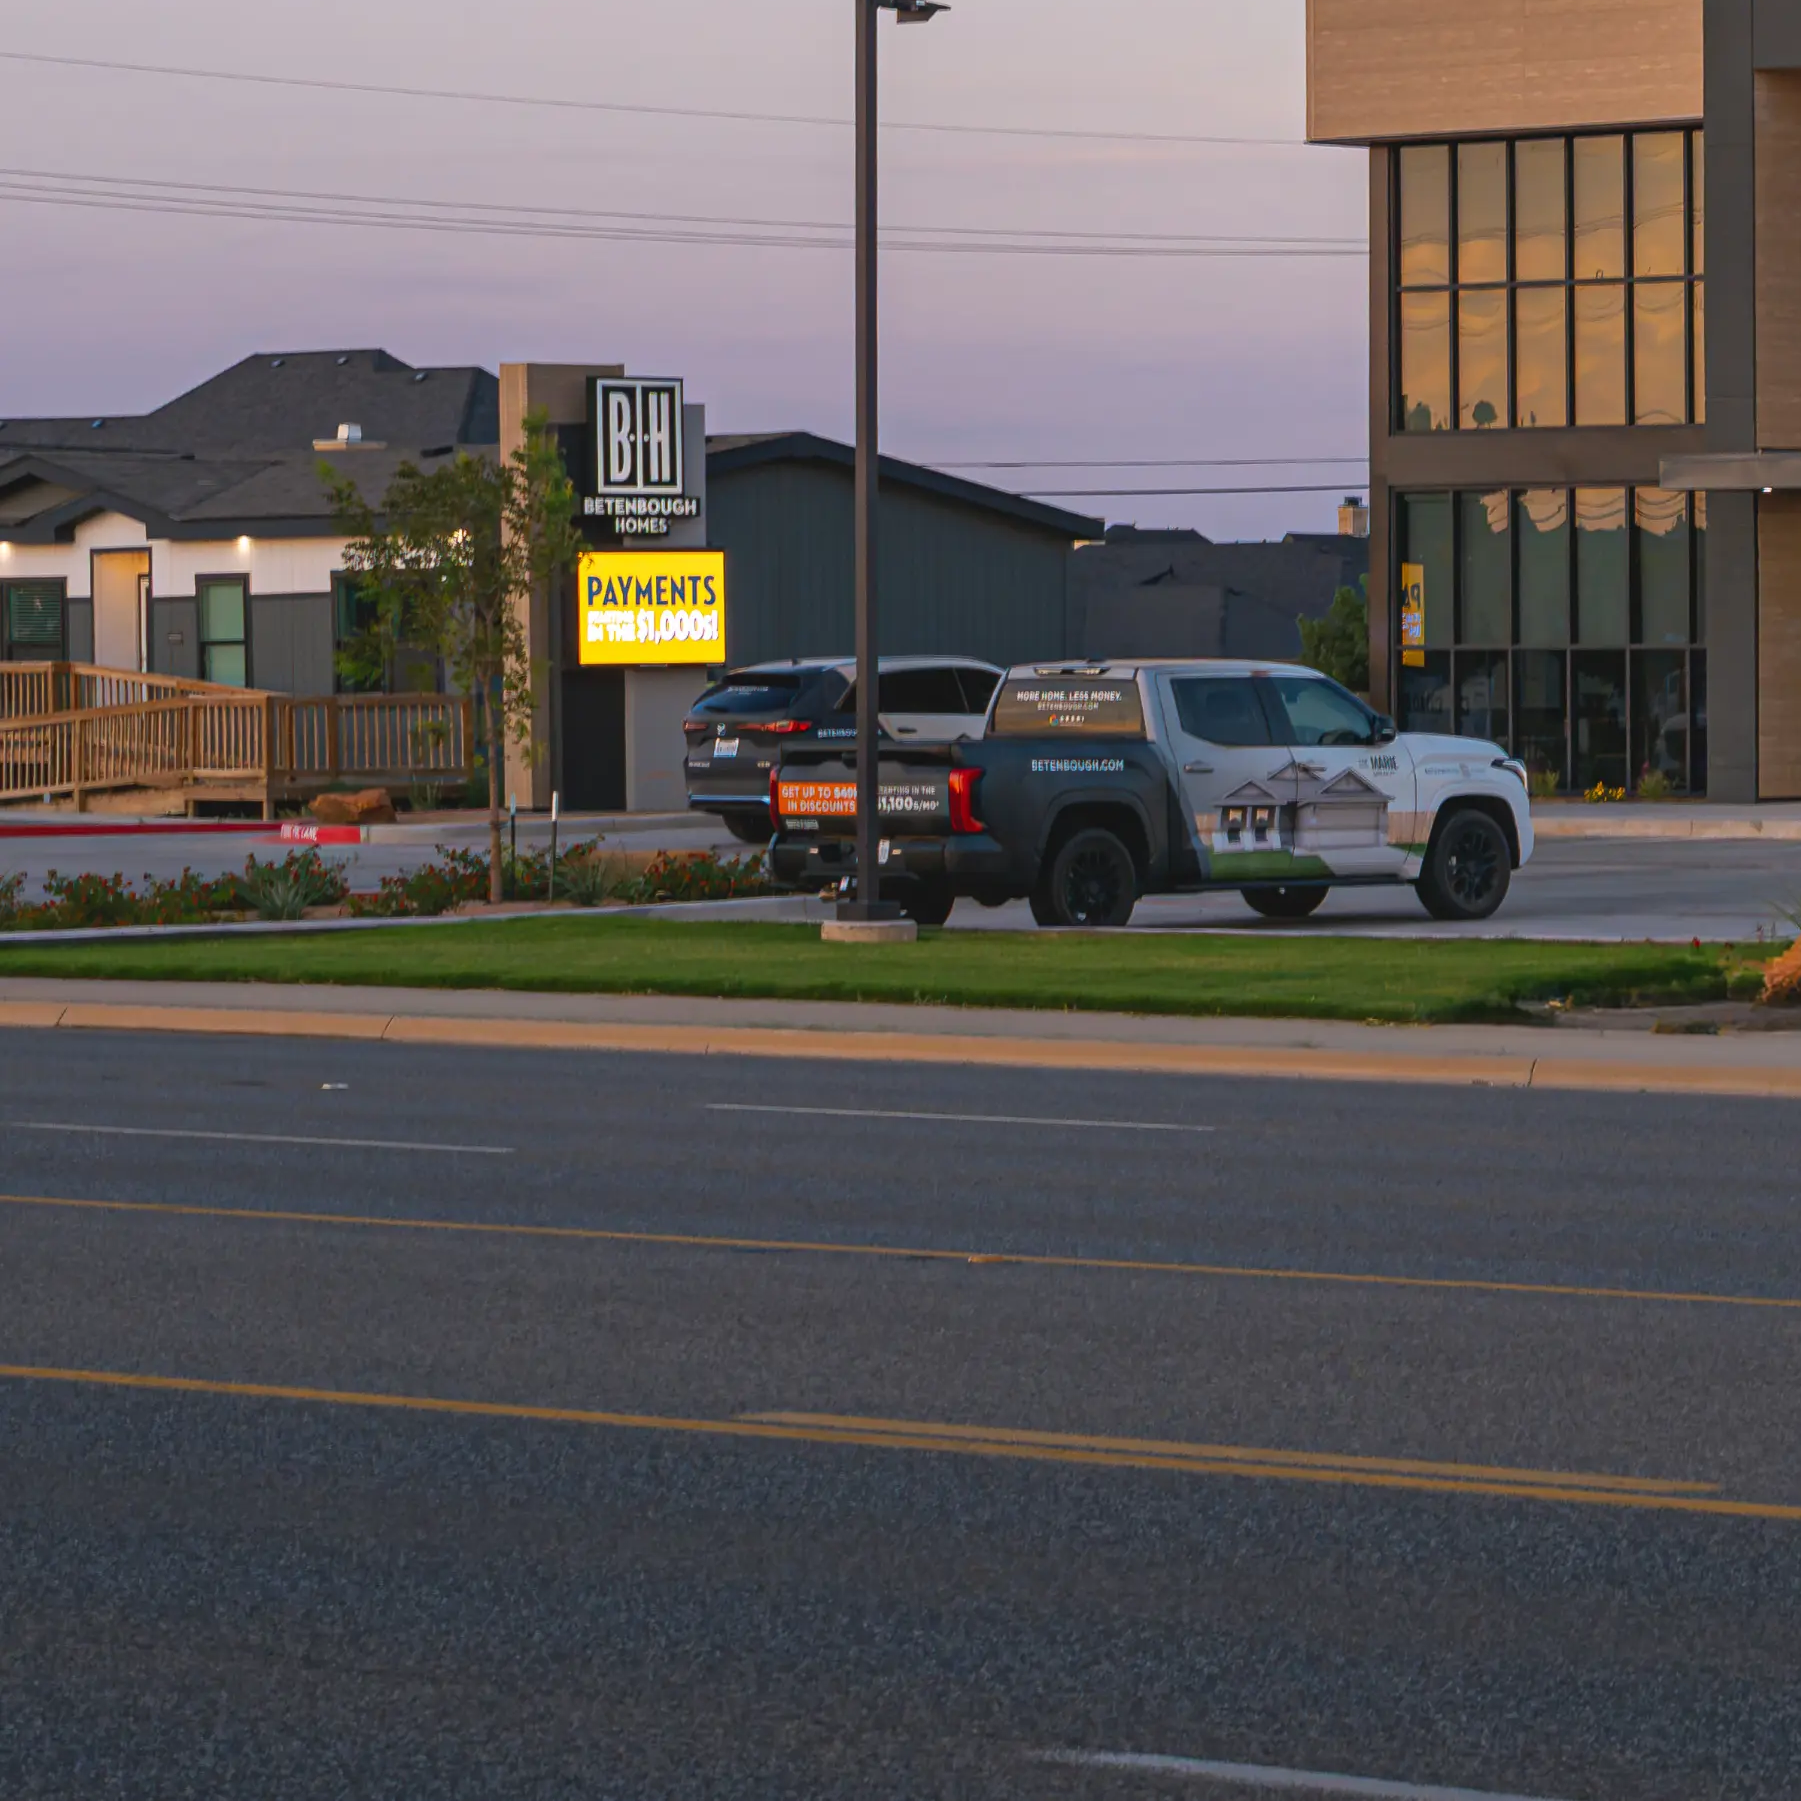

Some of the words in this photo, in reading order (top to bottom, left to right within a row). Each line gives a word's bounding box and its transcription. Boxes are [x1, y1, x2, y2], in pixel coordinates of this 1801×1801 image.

[584, 497, 697, 515] BETENBOUGH
[616, 517, 668, 533] HOMES
[587, 575, 716, 606] PAYMENTS
[1017, 691, 1040, 701] MORE
[1069, 691, 1089, 701] LESS
[1031, 759, 1124, 772] BETENBOUGH.COM
[782, 786, 799, 799] GET
[802, 786, 815, 799] UP
[818, 786, 831, 799] TO
[921, 785, 936, 796] THE
[788, 800, 797, 812] IN
[800, 800, 856, 812] DISCOUNTS
